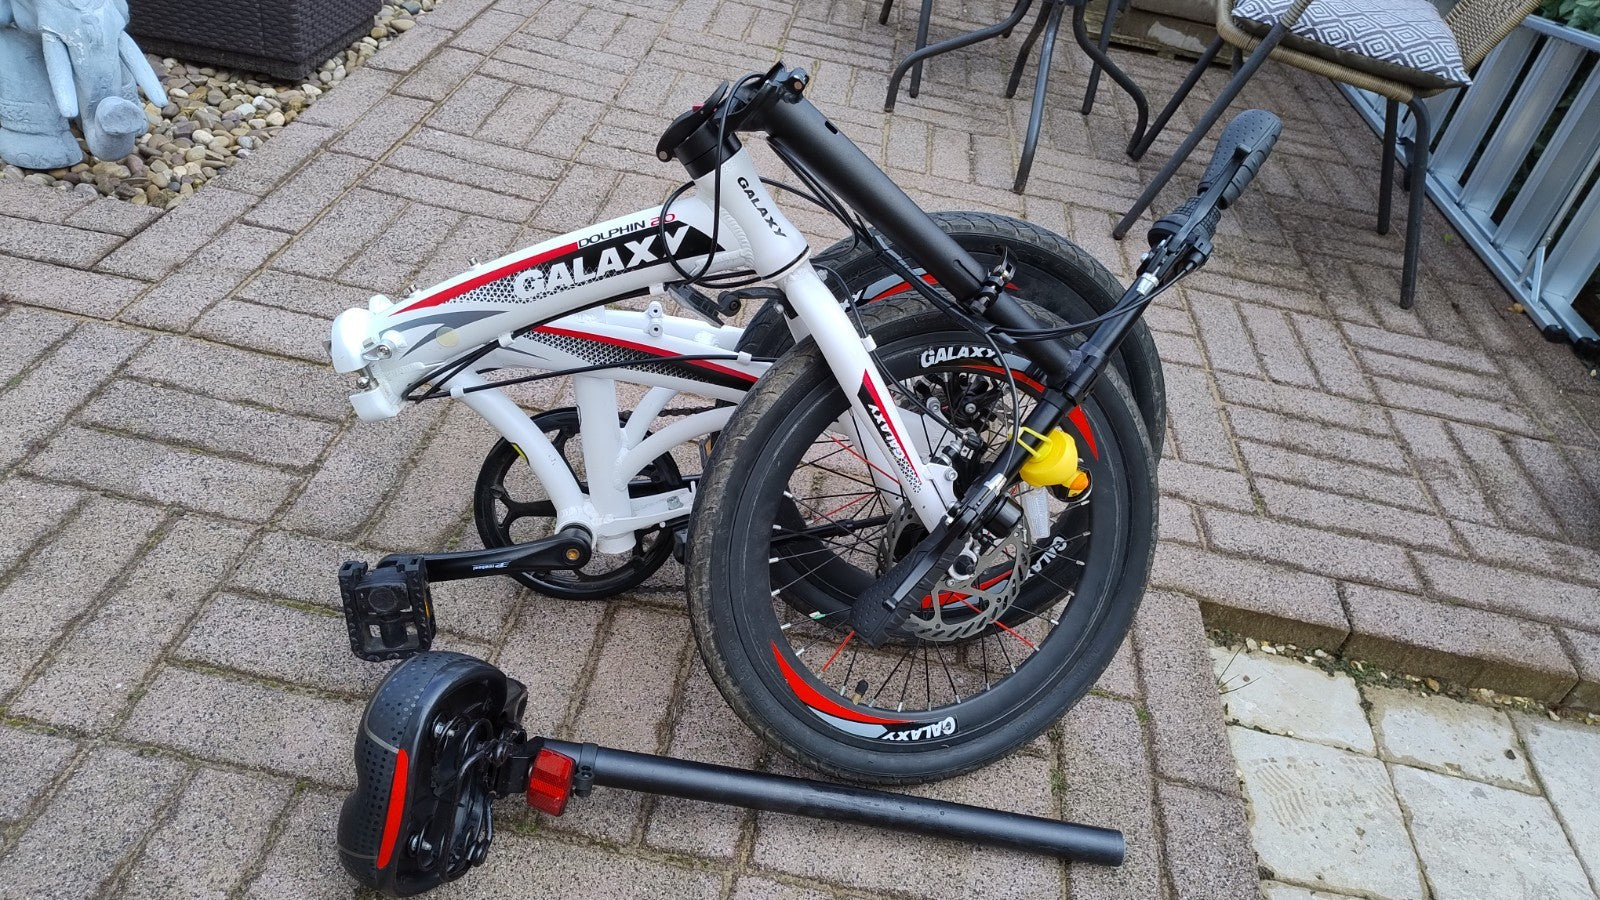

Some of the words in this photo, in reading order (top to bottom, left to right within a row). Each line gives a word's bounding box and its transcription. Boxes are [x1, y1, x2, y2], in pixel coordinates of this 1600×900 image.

[578, 220, 646, 249] DOLPHIN
[650, 213, 676, 227] 20
[737, 176, 787, 238] GALAXY
[513, 225, 690, 300] GALAXY
[868, 403, 906, 459] GALAXY
[881, 716, 956, 741] GALAXY
